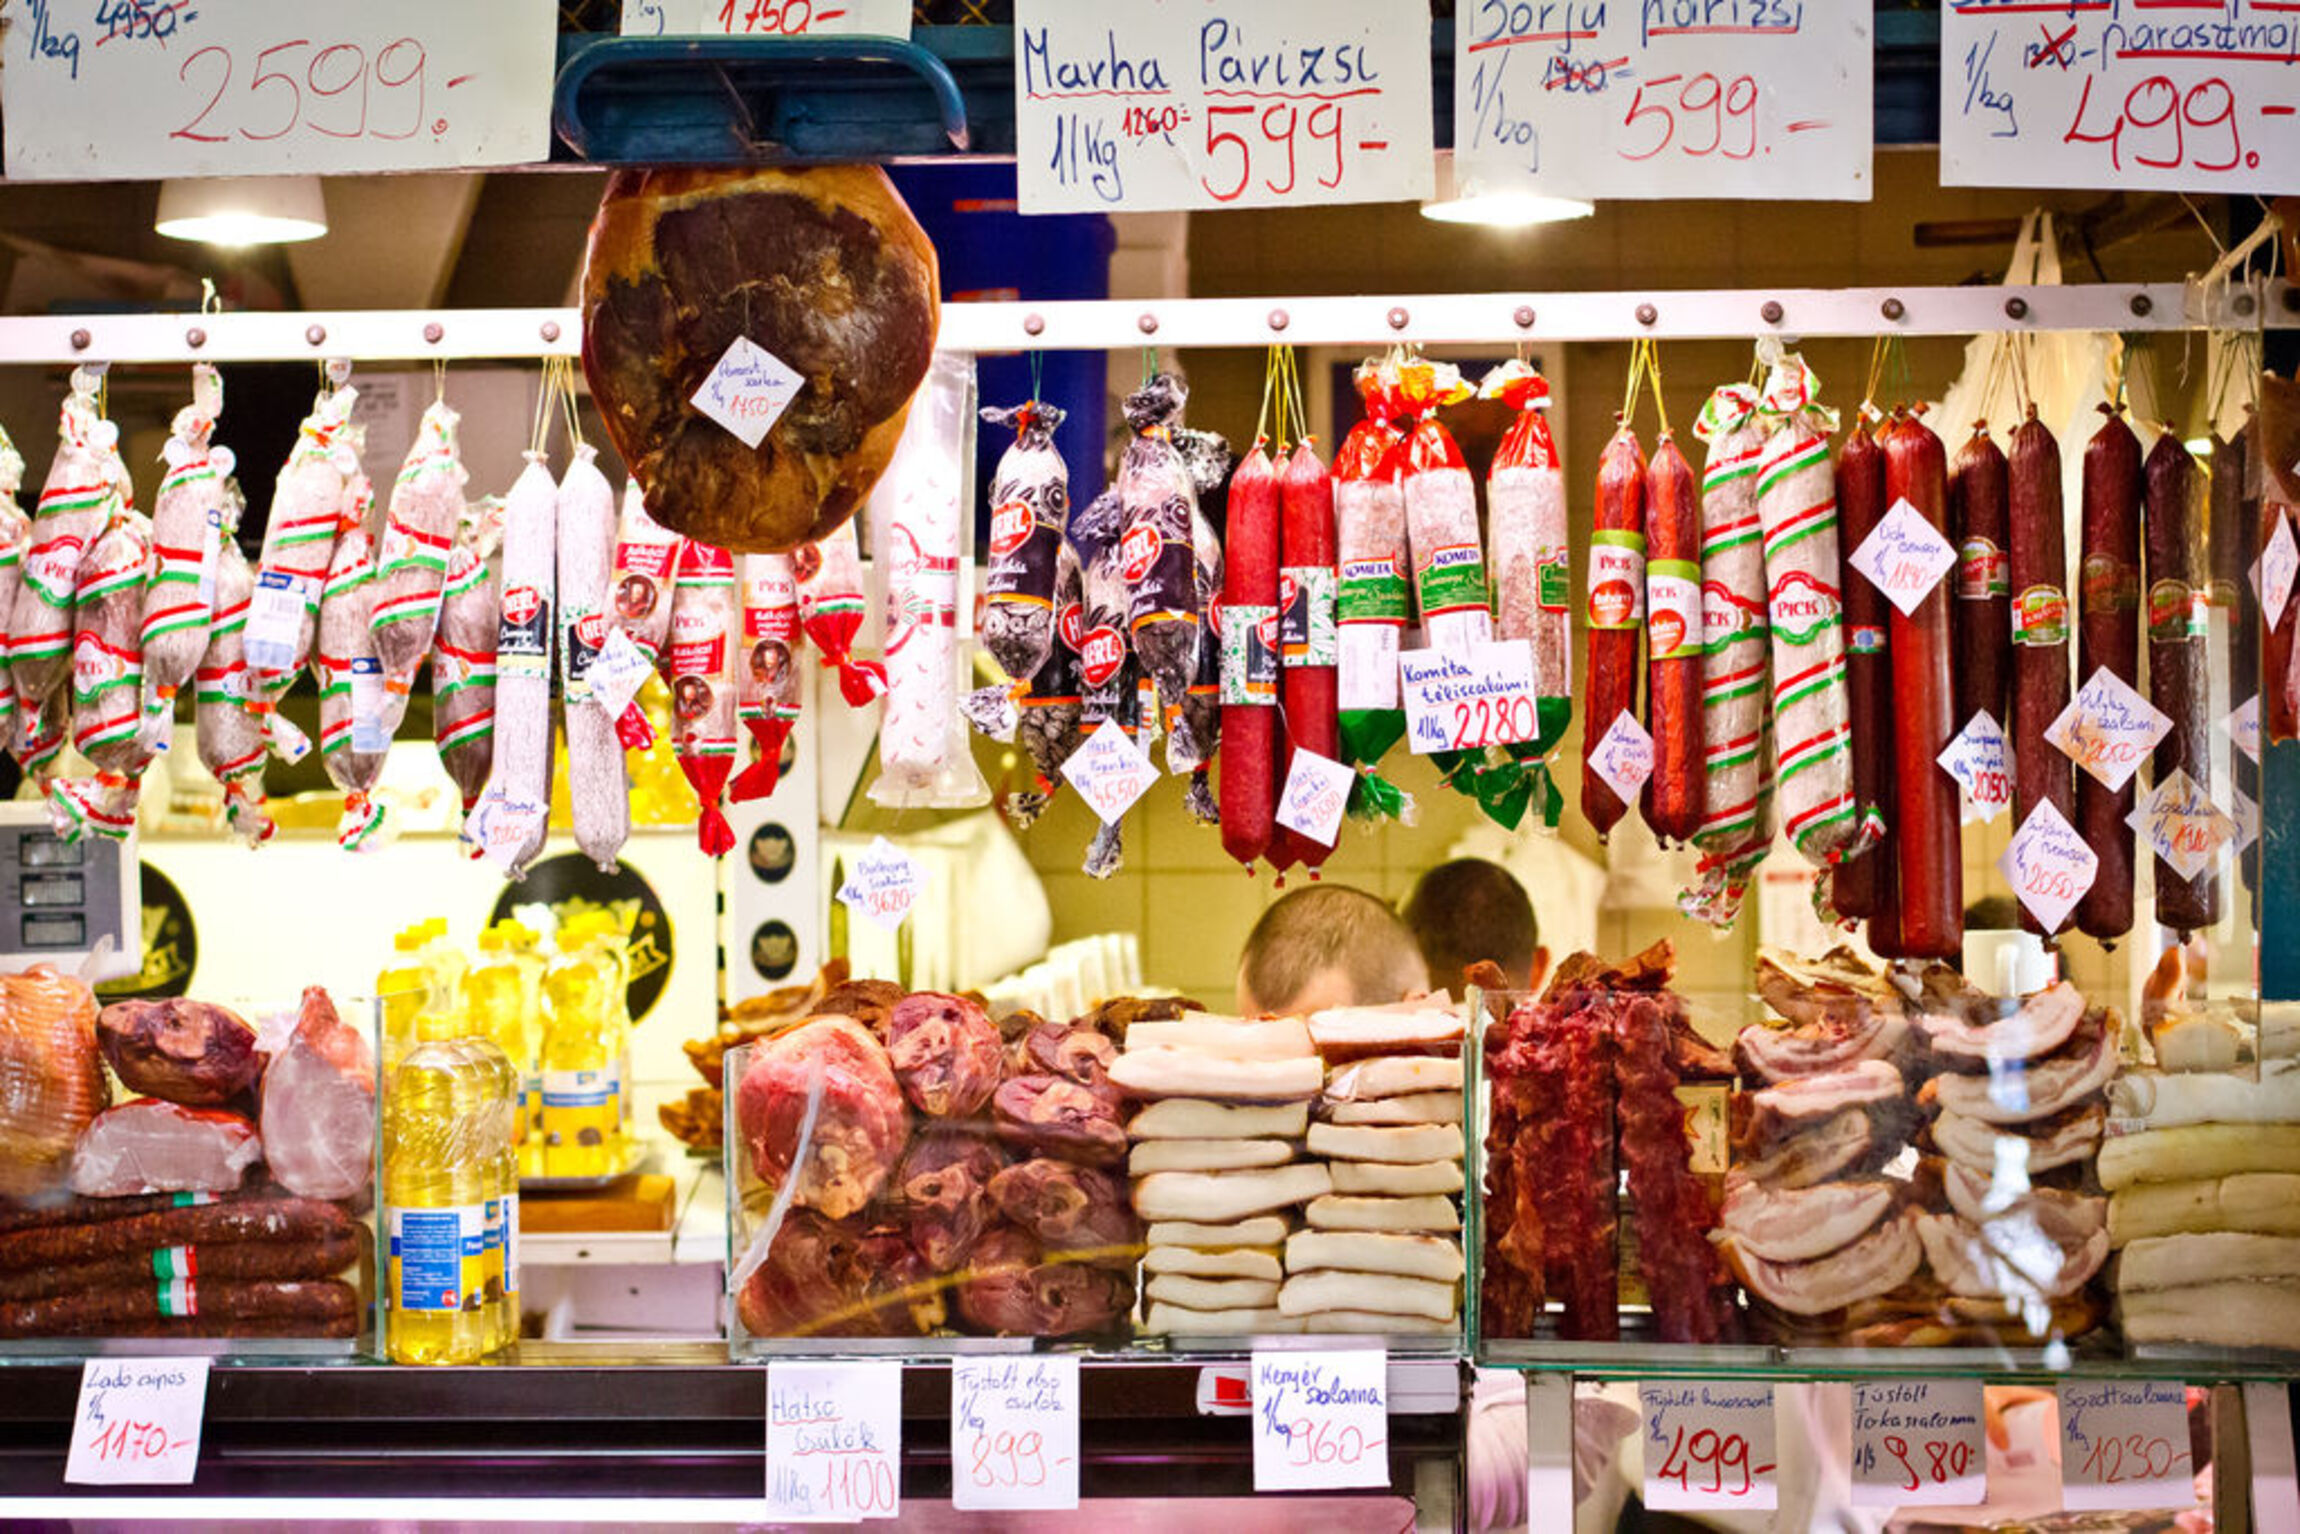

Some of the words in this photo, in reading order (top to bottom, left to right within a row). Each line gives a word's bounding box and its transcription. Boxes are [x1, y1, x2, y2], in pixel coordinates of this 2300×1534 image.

[1023, 27, 1170, 94] Marha
[1200, 17, 1379, 87] Párizsi
[1201, 103, 1388, 201] 599-
[1777, 601, 1819, 619] PICK
[1403, 655, 1472, 683] Kométa
[1453, 695, 1535, 750] 2280
[820, 1458, 895, 1512] 1100
